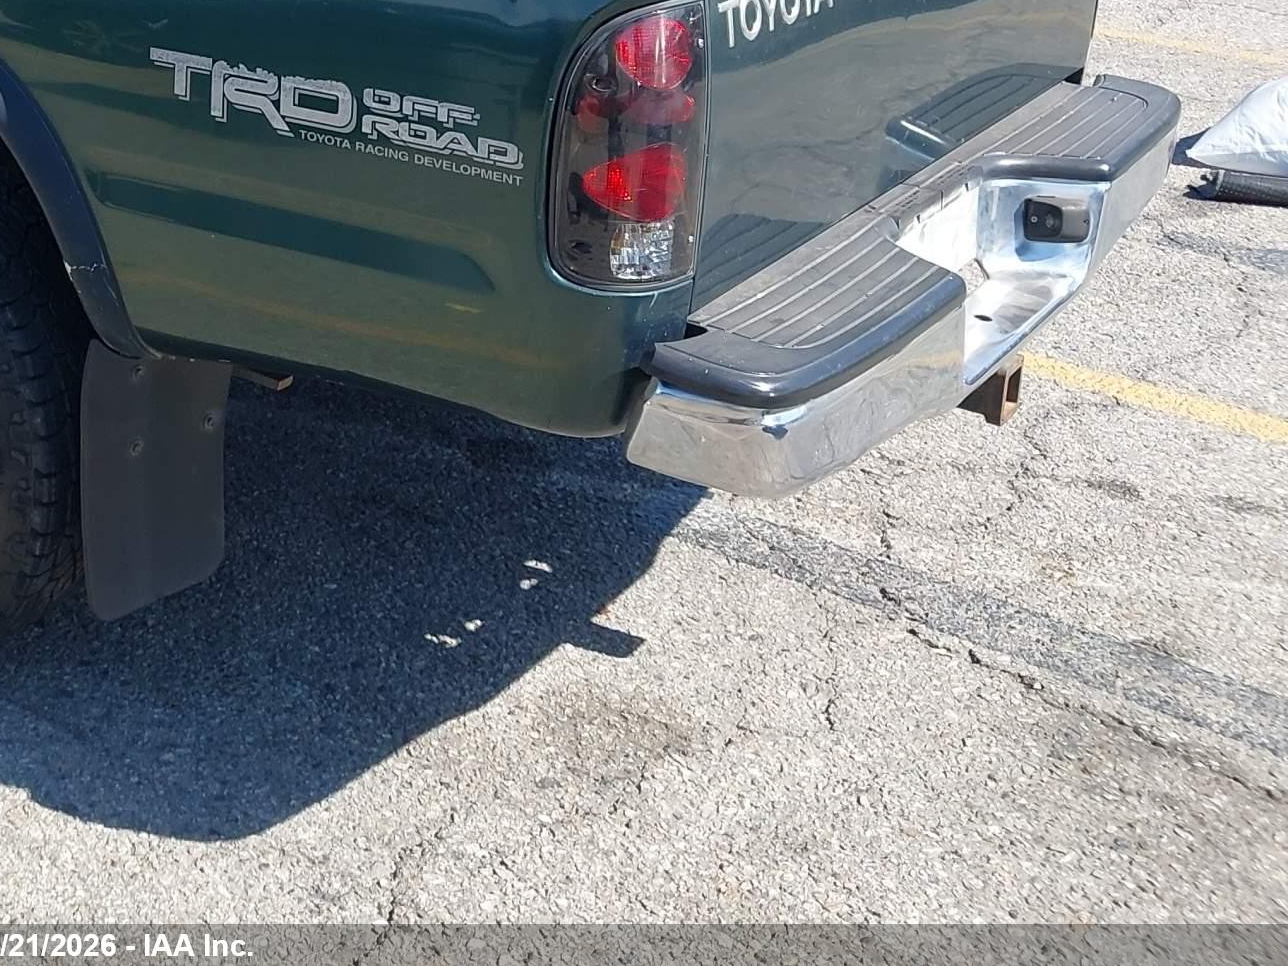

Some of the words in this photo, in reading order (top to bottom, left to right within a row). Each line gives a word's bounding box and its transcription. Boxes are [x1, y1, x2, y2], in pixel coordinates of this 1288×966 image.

[150, 47, 357, 138] TRD
[363, 88, 480, 128] OFF
[299, 129, 352, 150] TOYOTA
[355, 141, 409, 163] RACING
[414, 153, 524, 187] DEVELOPMENT
[362, 114, 524, 169] ROAD
